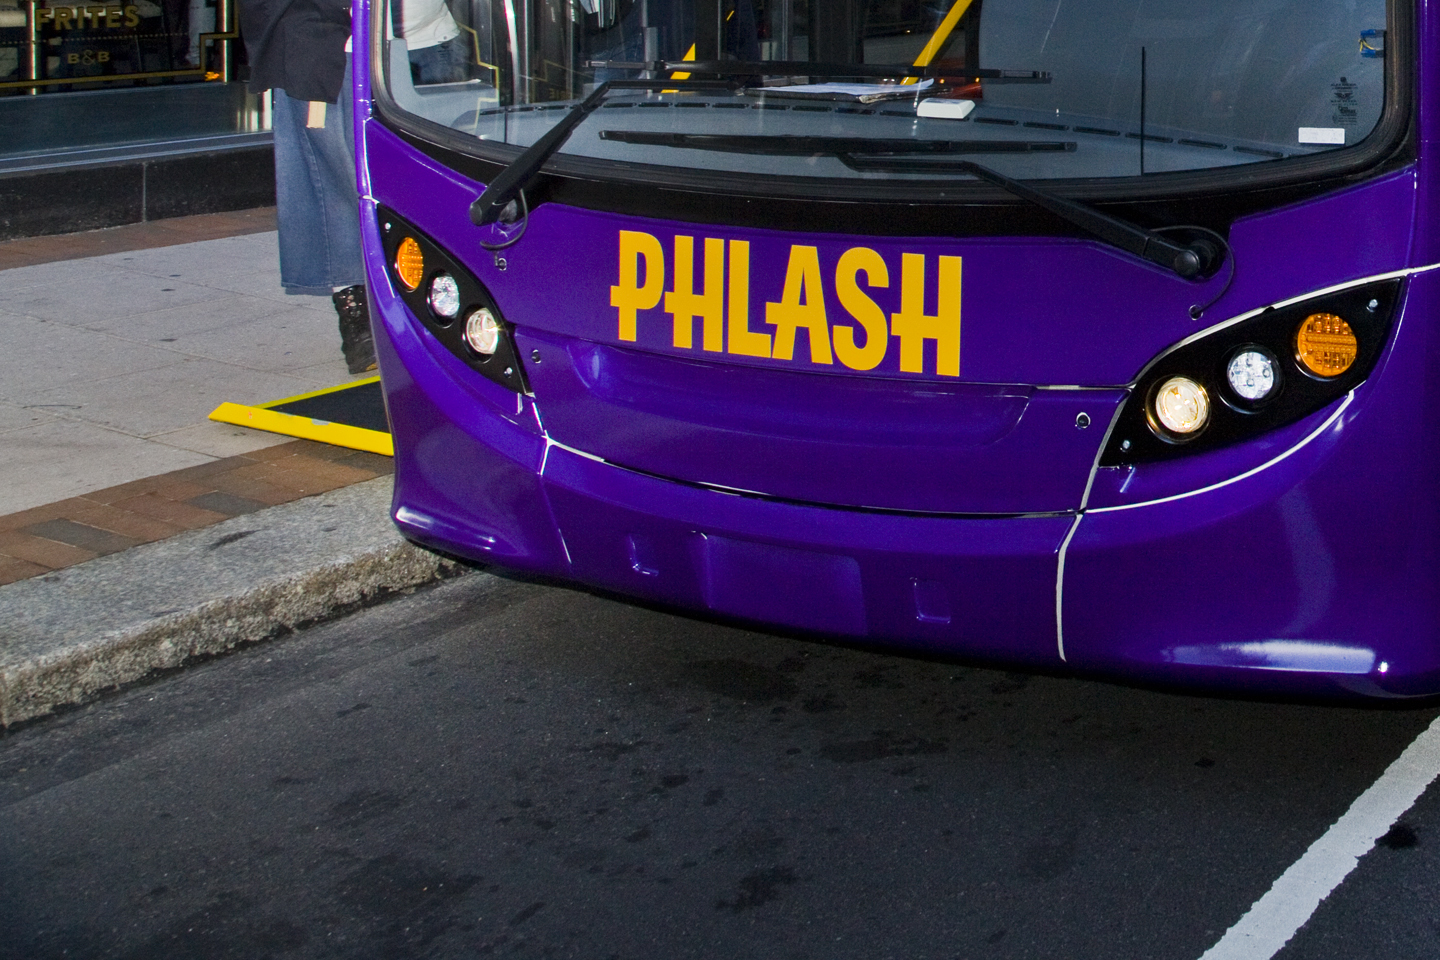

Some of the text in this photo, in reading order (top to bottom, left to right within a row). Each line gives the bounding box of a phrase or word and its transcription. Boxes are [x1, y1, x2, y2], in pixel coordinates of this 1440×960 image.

[35, 5, 140, 31] FRITES
[67, 49, 111, 66] B&B
[610, 229, 962, 377] PHLASH
